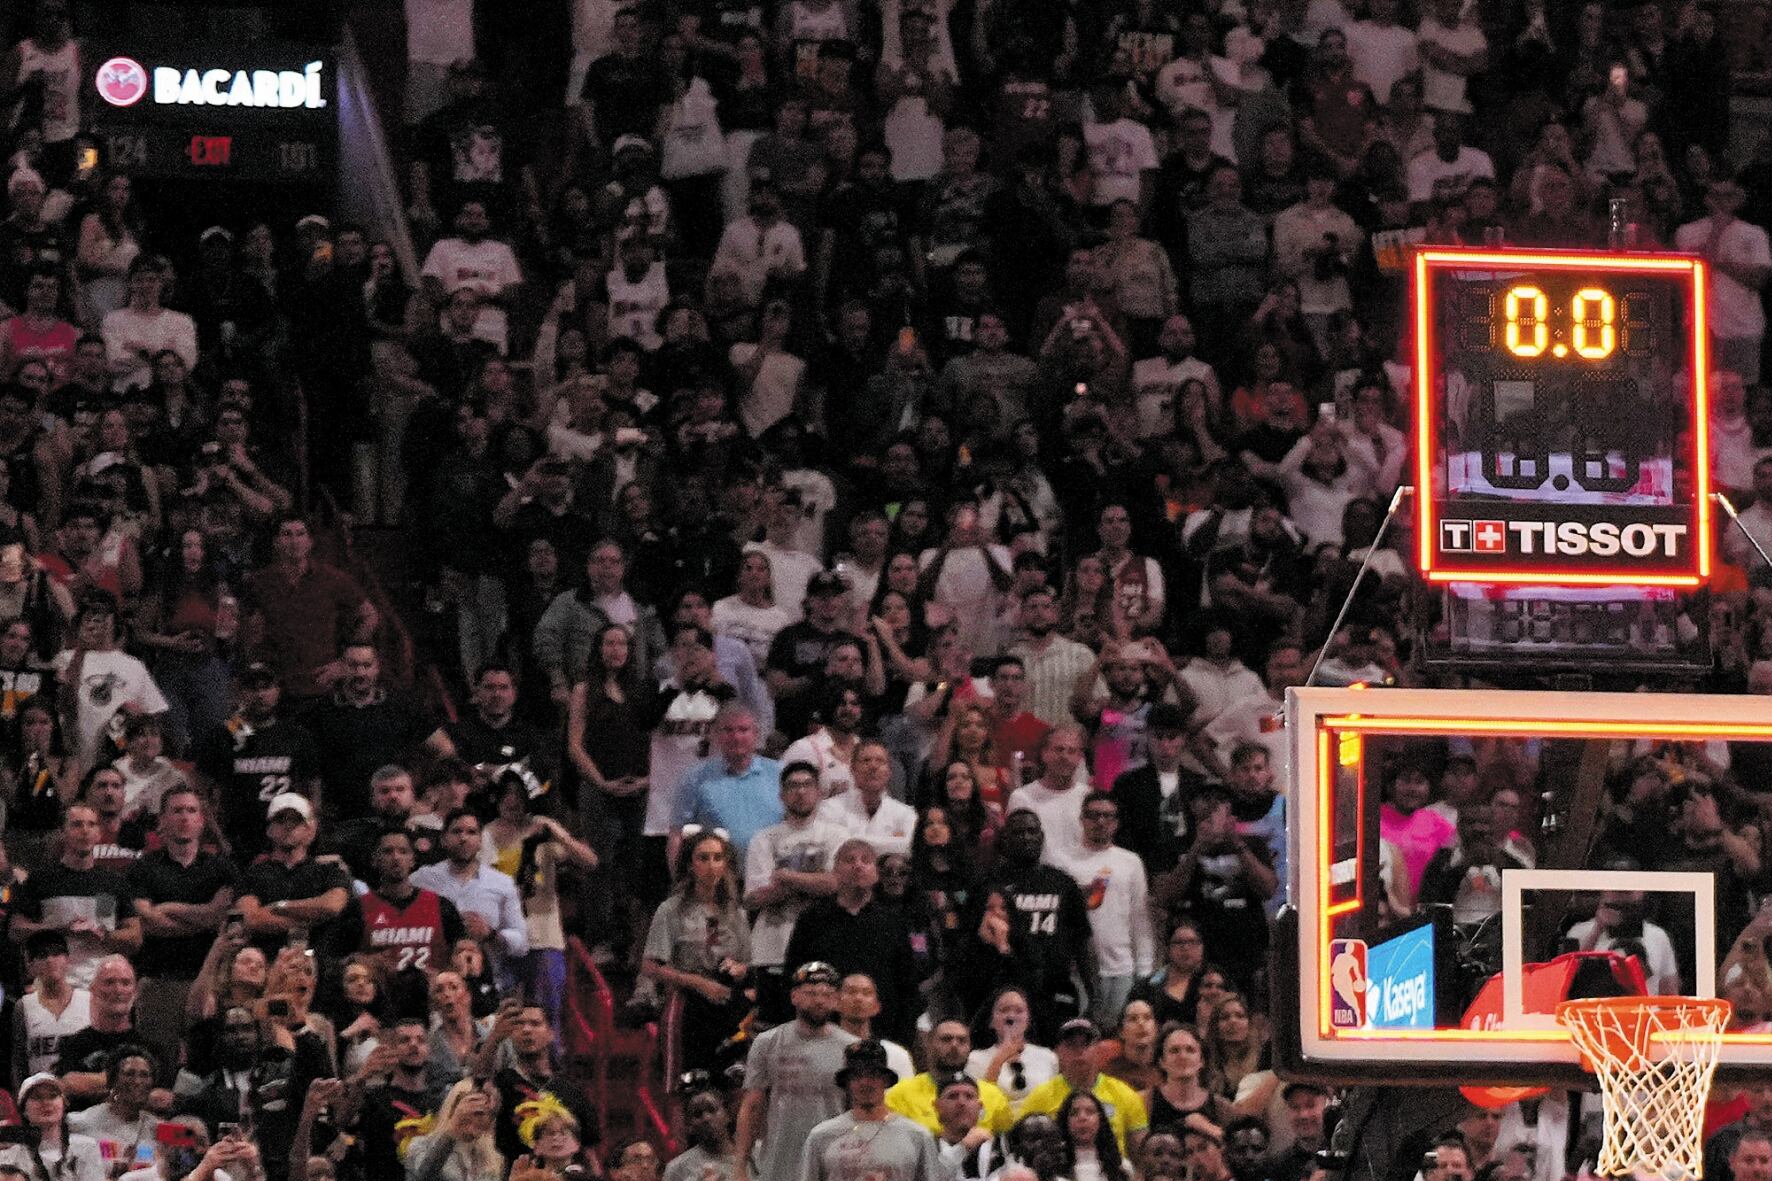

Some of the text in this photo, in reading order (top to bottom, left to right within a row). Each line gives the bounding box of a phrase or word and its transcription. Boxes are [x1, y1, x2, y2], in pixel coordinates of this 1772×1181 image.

[1505, 285, 1615, 360] 0.0
[1508, 520, 1687, 557] TISSOT
[1030, 911, 1058, 935] 14
[371, 926, 434, 946] MIAMI
[397, 946, 432, 971] 22
[1383, 970, 1427, 1026] Kaseya
[1333, 1008, 1354, 1025] NBA
